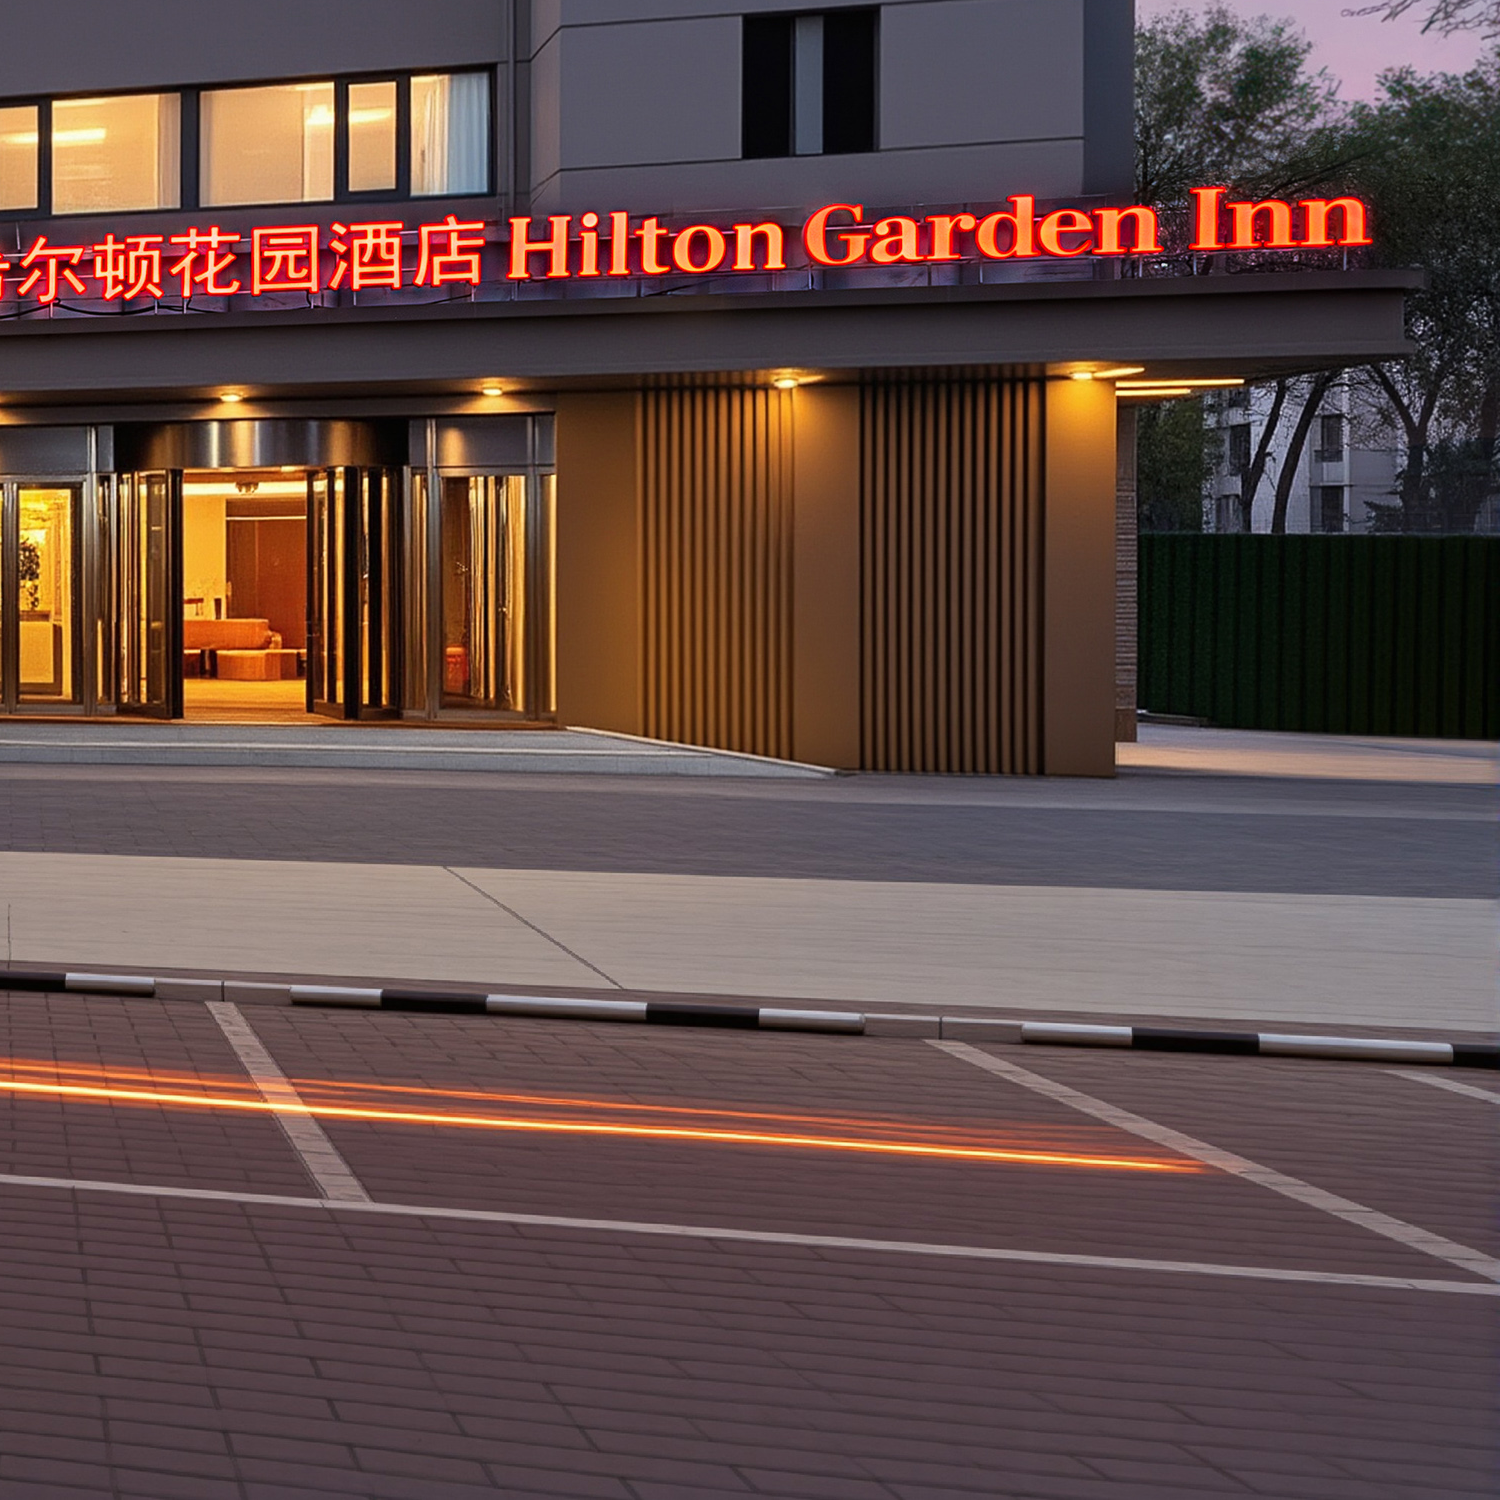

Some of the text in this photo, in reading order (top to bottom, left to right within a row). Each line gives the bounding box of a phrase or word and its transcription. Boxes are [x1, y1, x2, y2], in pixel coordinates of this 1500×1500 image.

[505, 185, 1373, 280] Hilton Garden Inn
